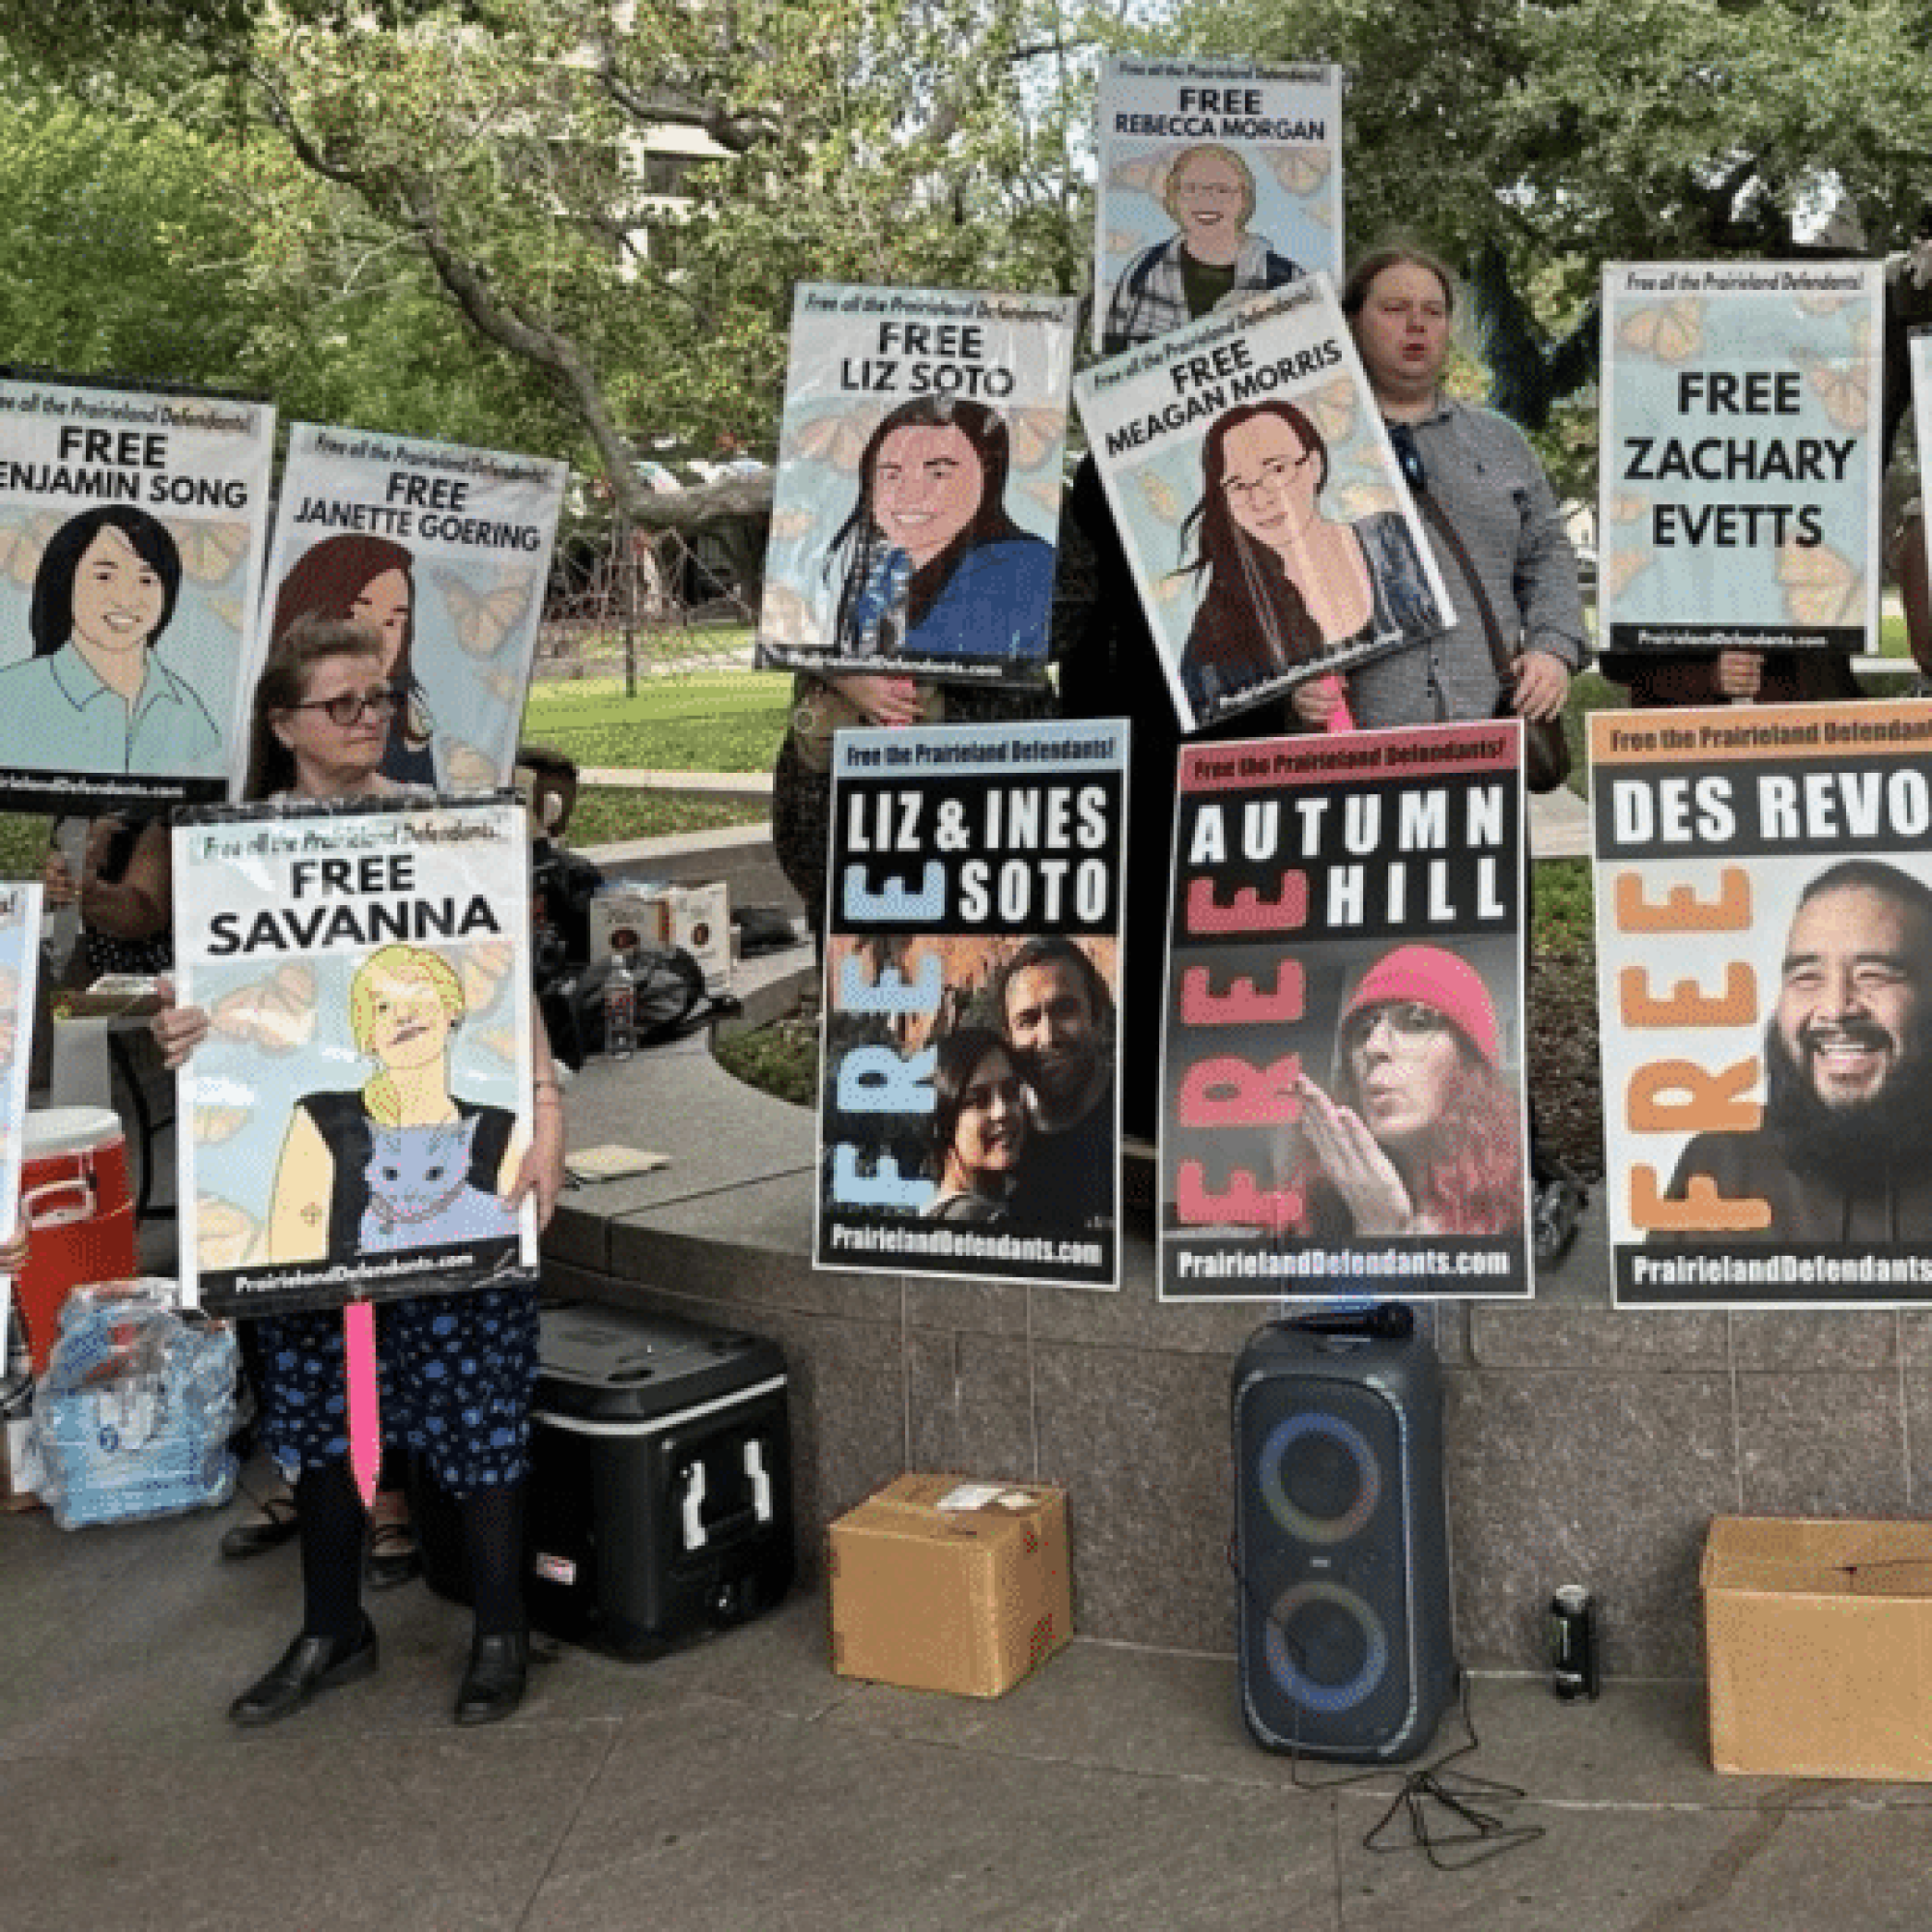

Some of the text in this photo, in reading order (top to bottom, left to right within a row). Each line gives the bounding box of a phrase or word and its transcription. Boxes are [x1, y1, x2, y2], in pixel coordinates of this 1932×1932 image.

[1179, 87, 1264, 115] FREE
[1115, 113, 1325, 141] REBECCA MORGAN
[1626, 271, 1657, 291] Free
[1659, 270, 1676, 291] all
[1678, 270, 1701, 291] the
[877, 321, 983, 358] FREE
[840, 357, 1016, 398] LIZ SOTO
[1170, 338, 1253, 396] FREE
[1105, 339, 1344, 458] MEAGAN MORRIS
[1677, 371, 1801, 414] FREE
[58, 425, 169, 469] FREE
[1623, 438, 1858, 481] ZACHARY
[149, 473, 249, 509] SONG
[386, 470, 469, 512] FREE
[294, 497, 541, 553] JANETTE GOERING
[1653, 503, 1824, 548] EVETTS
[846, 737, 1116, 767] Free the Prairieland Defendants!
[1194, 737, 1507, 779] Free the Prairieland Defendants!
[1609, 728, 1658, 752] Free
[1659, 727, 1696, 750] the
[1698, 722, 1820, 749] Prairieland
[846, 785, 1108, 854] LIZ & INES
[1187, 783, 1505, 865] AUTUMN
[1611, 767, 1932, 844] DES REVO
[291, 853, 415, 899] FREE
[958, 858, 1108, 923] SOTO
[1325, 857, 1506, 927] HILL
[207, 894, 501, 955] SAVANNA
[832, 860, 947, 1208] FREE
[1176, 867, 1309, 1228] FREE
[1614, 866, 1772, 1232] FREE
[831, 1222, 1104, 1267] PrairielandDefendants.com
[1177, 1250, 1512, 1279] PrairielandDefendants.com
